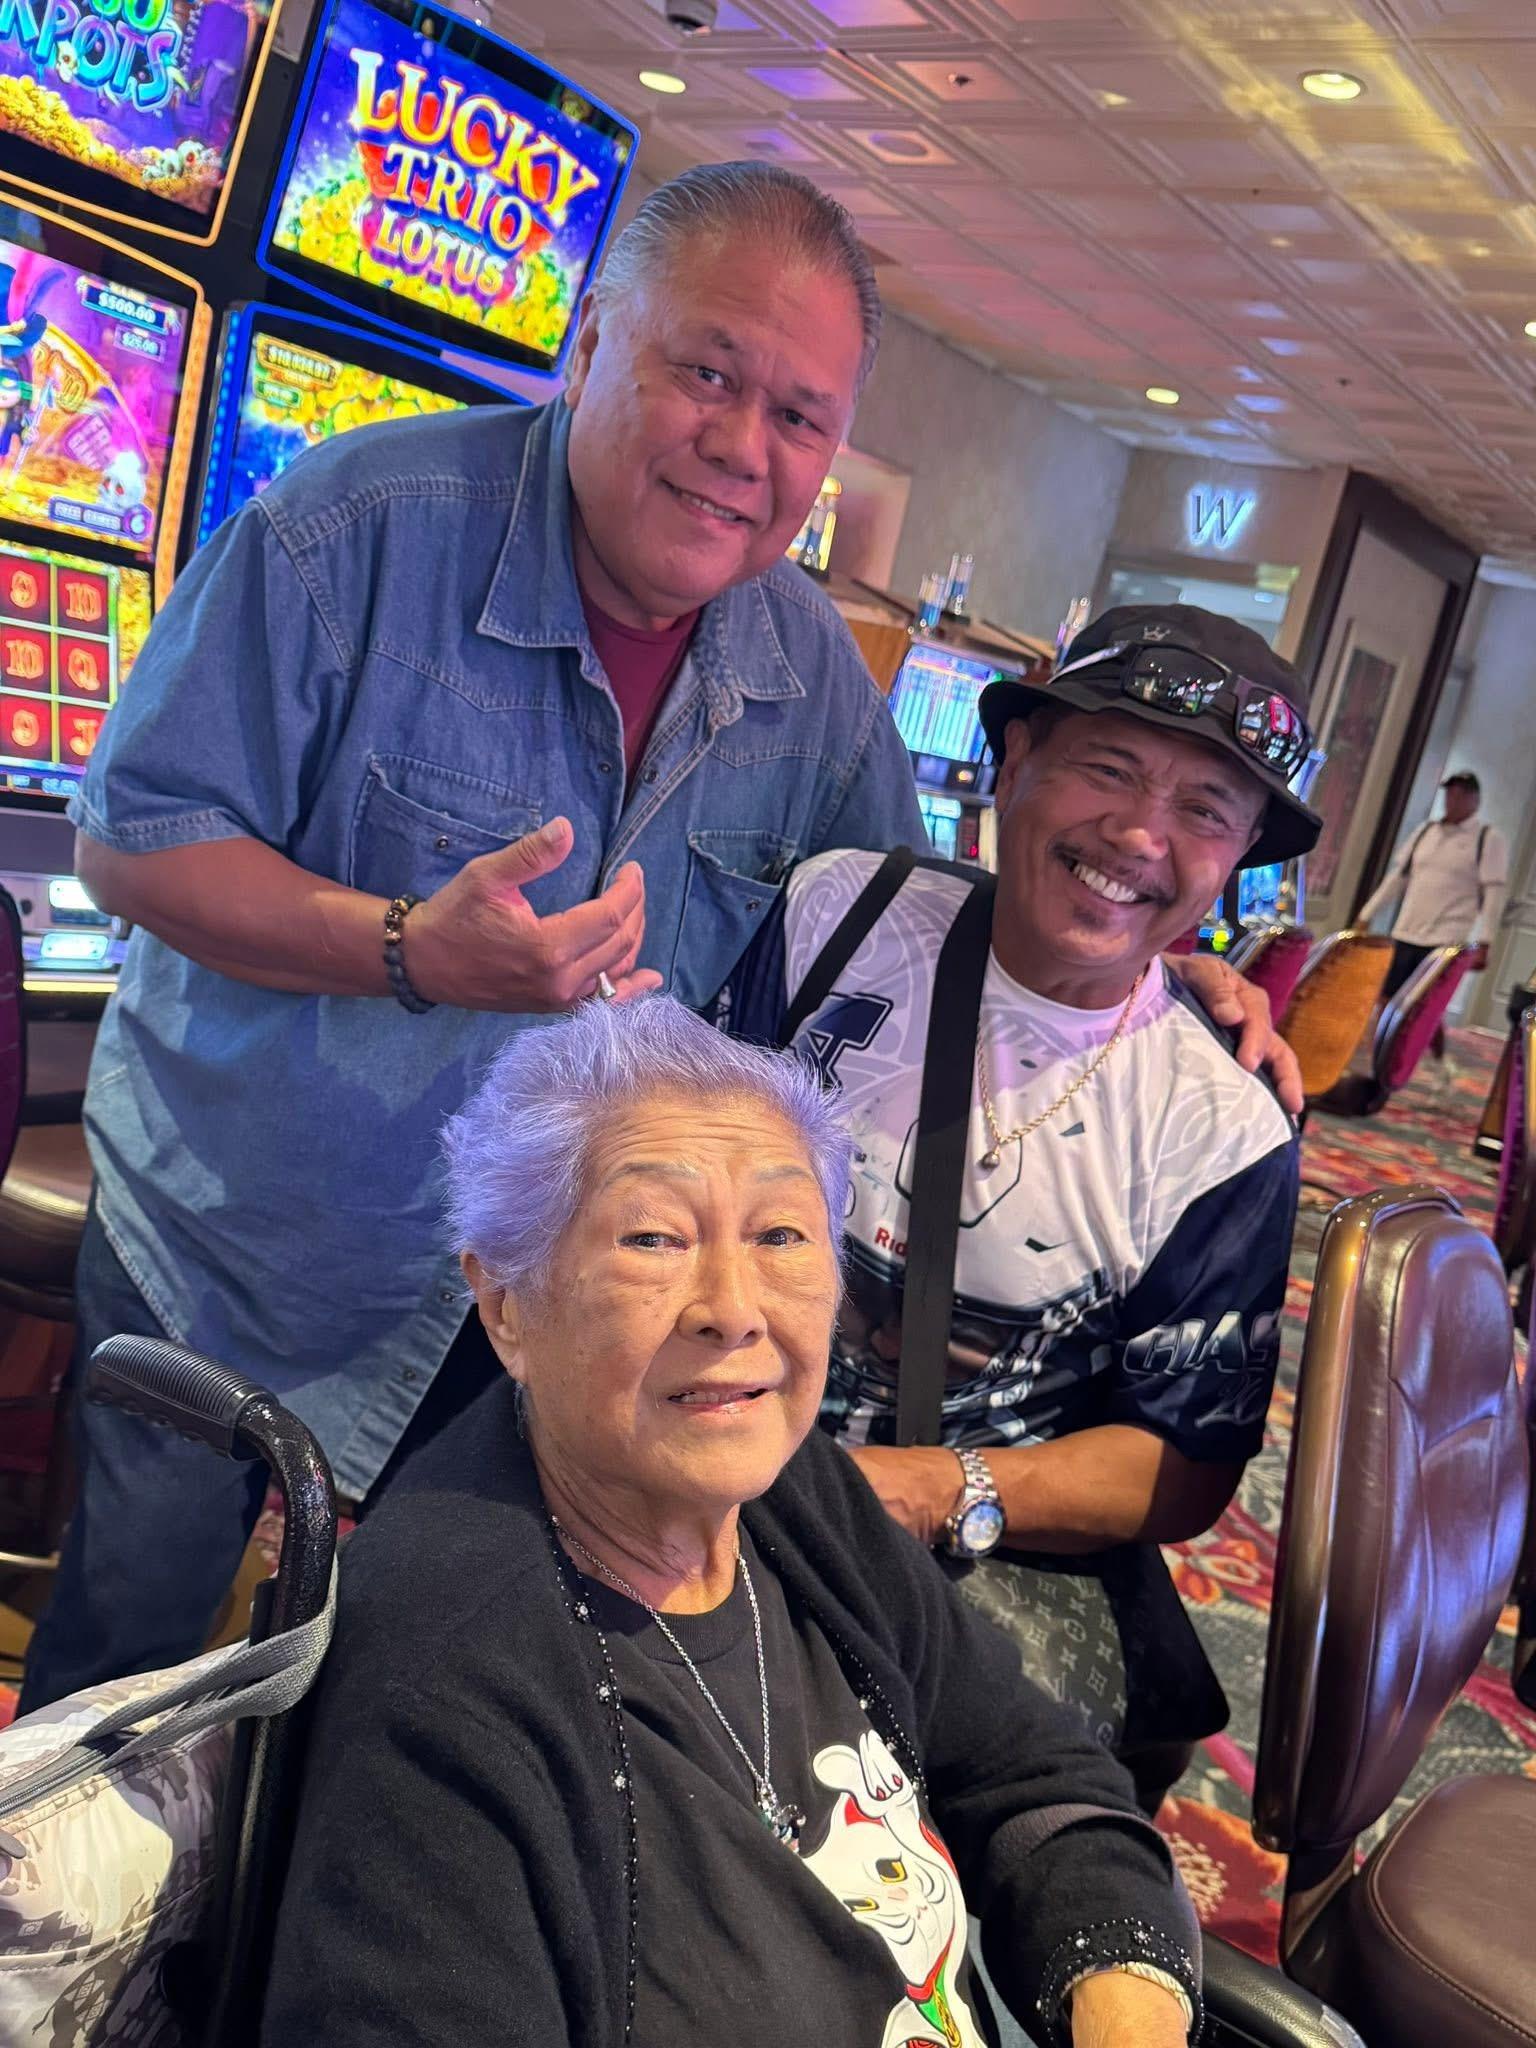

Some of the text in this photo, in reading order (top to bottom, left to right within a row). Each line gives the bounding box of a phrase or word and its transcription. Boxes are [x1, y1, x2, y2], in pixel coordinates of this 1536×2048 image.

[350, 47, 600, 227] LUCKY
[384, 143, 532, 251] TRIO
[374, 205, 509, 296] LOTUS
[1188, 486, 1255, 548] W
[64, 582, 102, 622] 10
[6, 639, 100, 691] 10 Q
